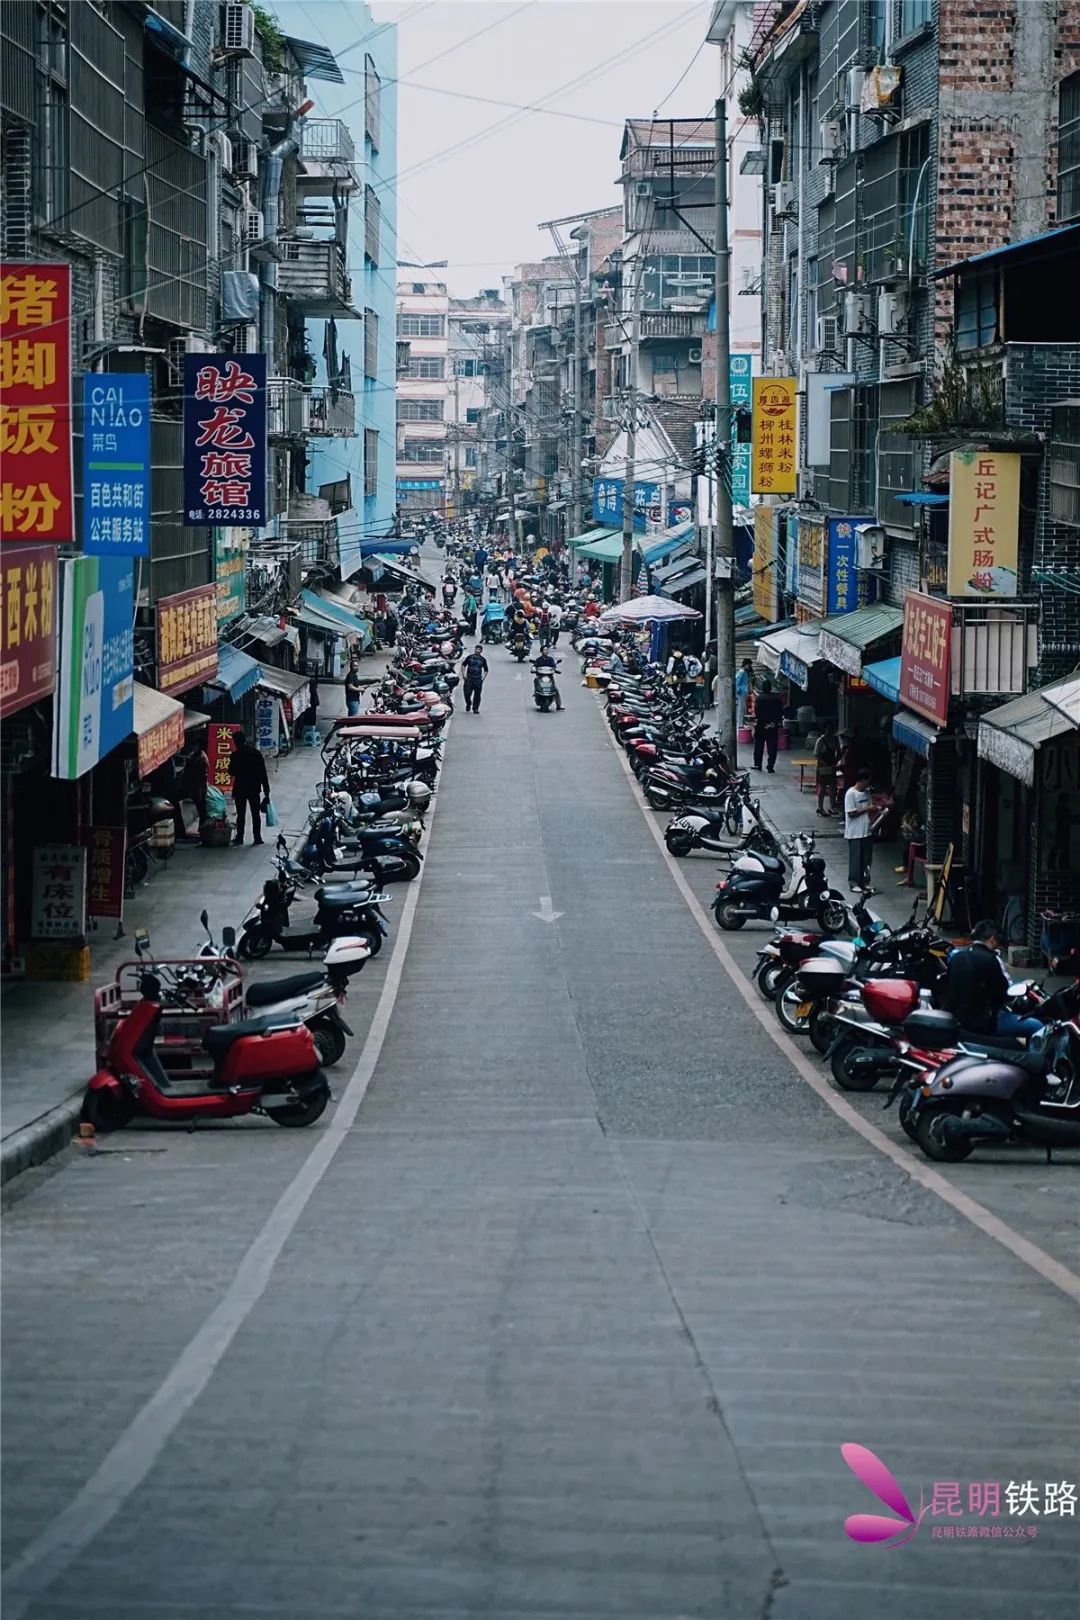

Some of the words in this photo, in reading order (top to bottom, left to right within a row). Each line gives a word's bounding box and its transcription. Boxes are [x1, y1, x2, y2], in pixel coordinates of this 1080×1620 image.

[91, 387, 123, 406] CAI
[92, 434, 117, 452] 菜鸟
[195, 360, 257, 507] 映龙旅馆
[778, 419, 794, 474] 桂林米粉
[91, 482, 144, 509] 百色共和街
[208, 508, 260, 520] 2824336
[90, 517, 144, 543] 公共服务站
[972, 459, 997, 591] 丘记广式肠粉
[214, 726, 233, 785] 米已成粥
[42, 864, 76, 919] 有床位
[90, 830, 112, 903] 骨质增生
